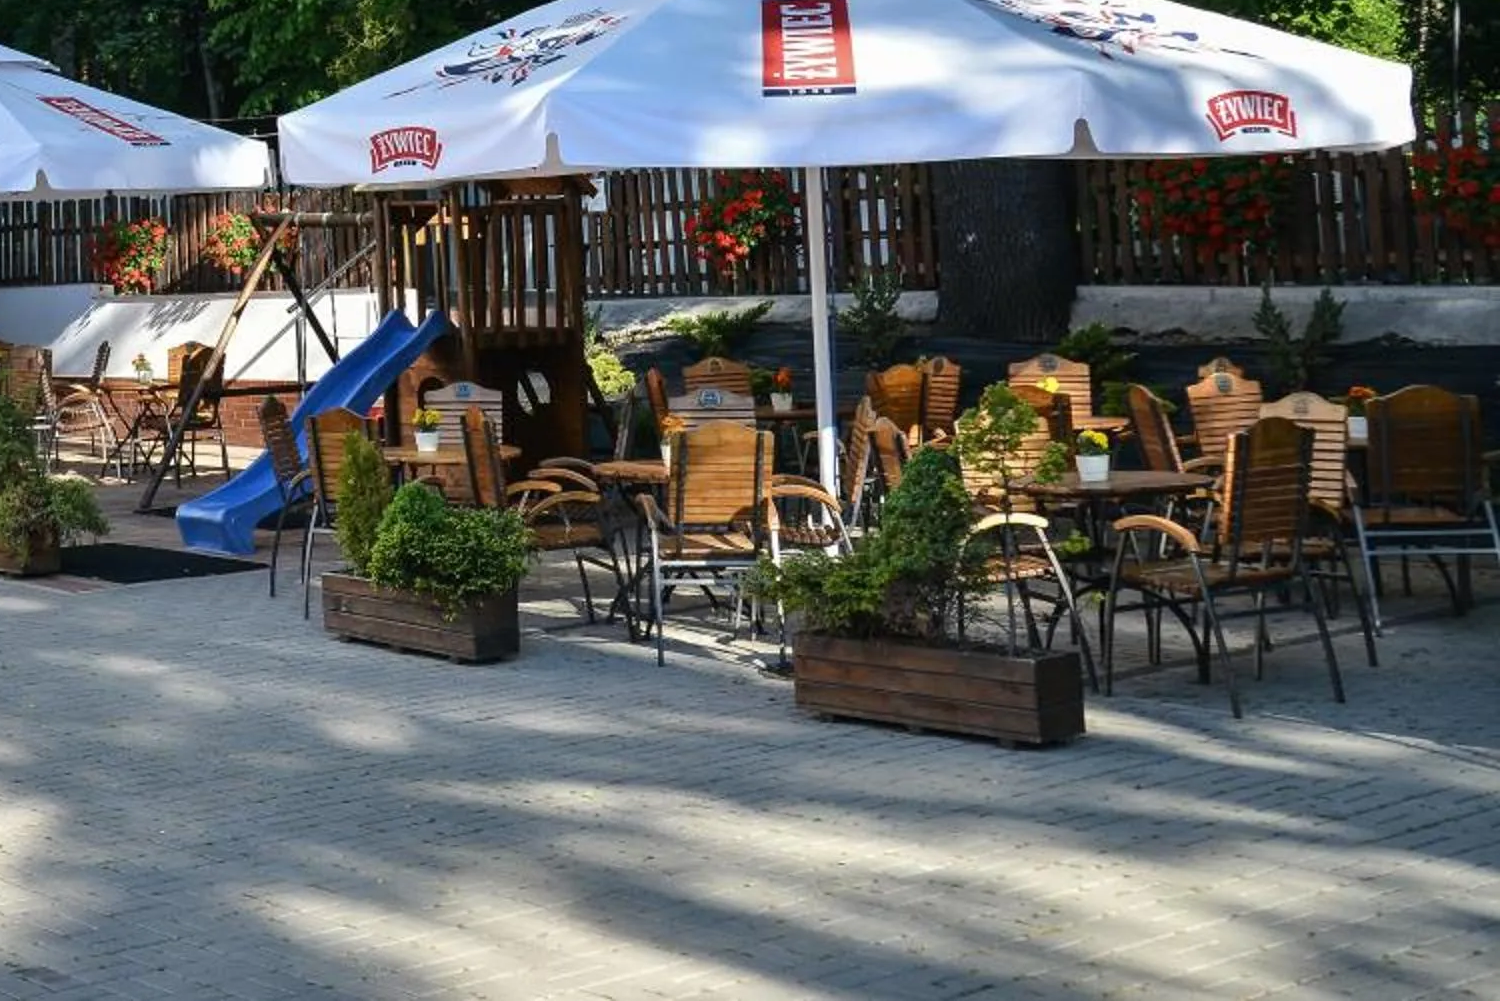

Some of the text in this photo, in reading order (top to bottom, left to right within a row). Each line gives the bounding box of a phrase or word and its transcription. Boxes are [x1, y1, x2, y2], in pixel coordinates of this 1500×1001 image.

[772, 2, 837, 80] ŻYWIEC
[1215, 94, 1284, 126] ŻYWIEC
[375, 130, 431, 160] ŻYWIEC
